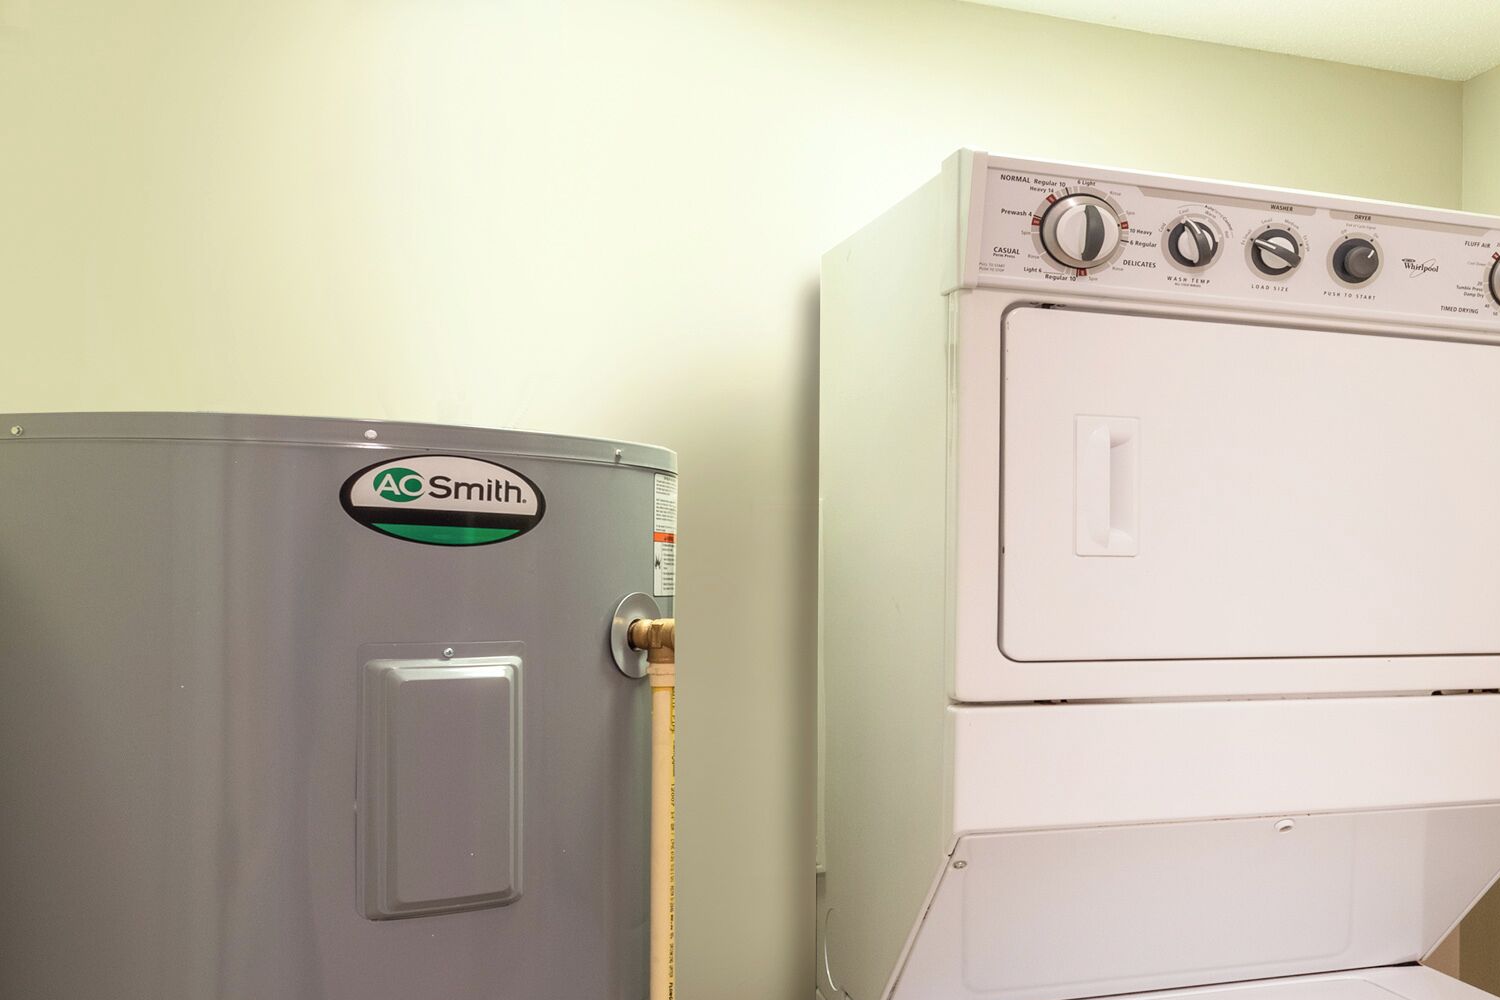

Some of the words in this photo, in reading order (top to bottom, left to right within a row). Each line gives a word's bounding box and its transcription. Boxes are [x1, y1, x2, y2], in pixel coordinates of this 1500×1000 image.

[1000, 174, 1031, 184] NORMAL
[1034, 179, 1057, 187] Regular
[1000, 208, 1027, 217] Prewash
[1270, 204, 1294, 212] WASHER
[1135, 240, 1157, 248] Regular
[1464, 240, 1480, 248] FLUFF
[993, 246, 1021, 255] CASUAL
[1122, 259, 1157, 269] DELICATES
[1404, 262, 1439, 273] Whirlpool
[1045, 273, 1068, 281] Regular
[428, 475, 523, 504] Smith
